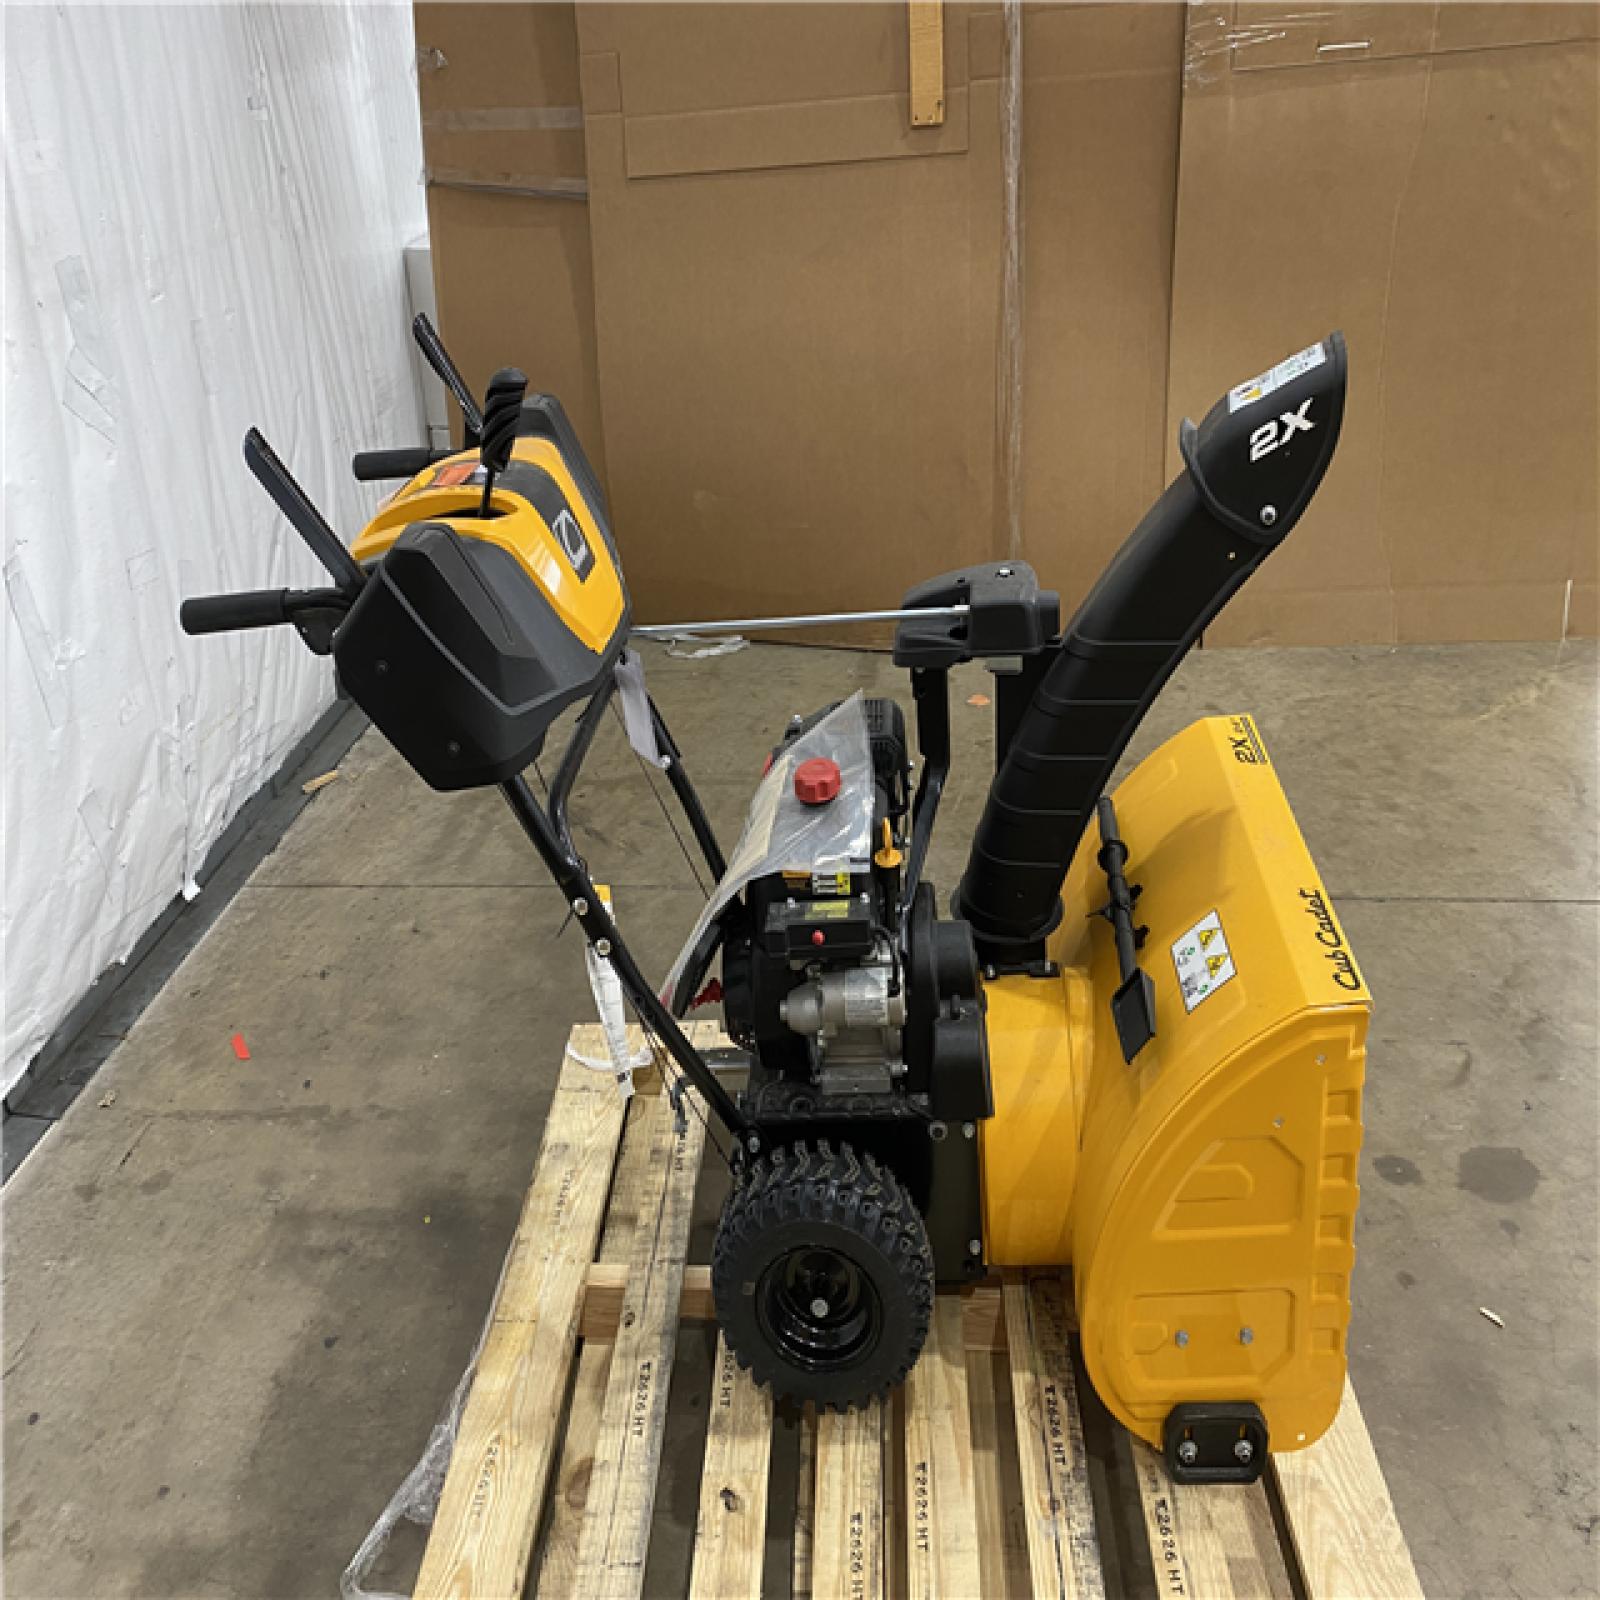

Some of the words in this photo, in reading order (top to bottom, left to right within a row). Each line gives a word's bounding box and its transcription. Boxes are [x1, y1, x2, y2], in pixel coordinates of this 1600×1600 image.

[1249, 397, 1316, 463] 2X
[1229, 737, 1257, 764] 2X
[1299, 887, 1343, 949] Cadet
[1325, 949, 1361, 991] Cub
[635, 1361, 652, 1412] T2626
[1044, 1384, 1061, 1438] T2626
[631, 1415, 645, 1437] HT
[1052, 1442, 1066, 1465] HT
[914, 1461, 929, 1521] T2626
[849, 1511, 864, 1574] T2626
[915, 1526, 929, 1552] HT
[1155, 1497, 1178, 1563] T2626
[1167, 1568, 1185, 1596] HT
